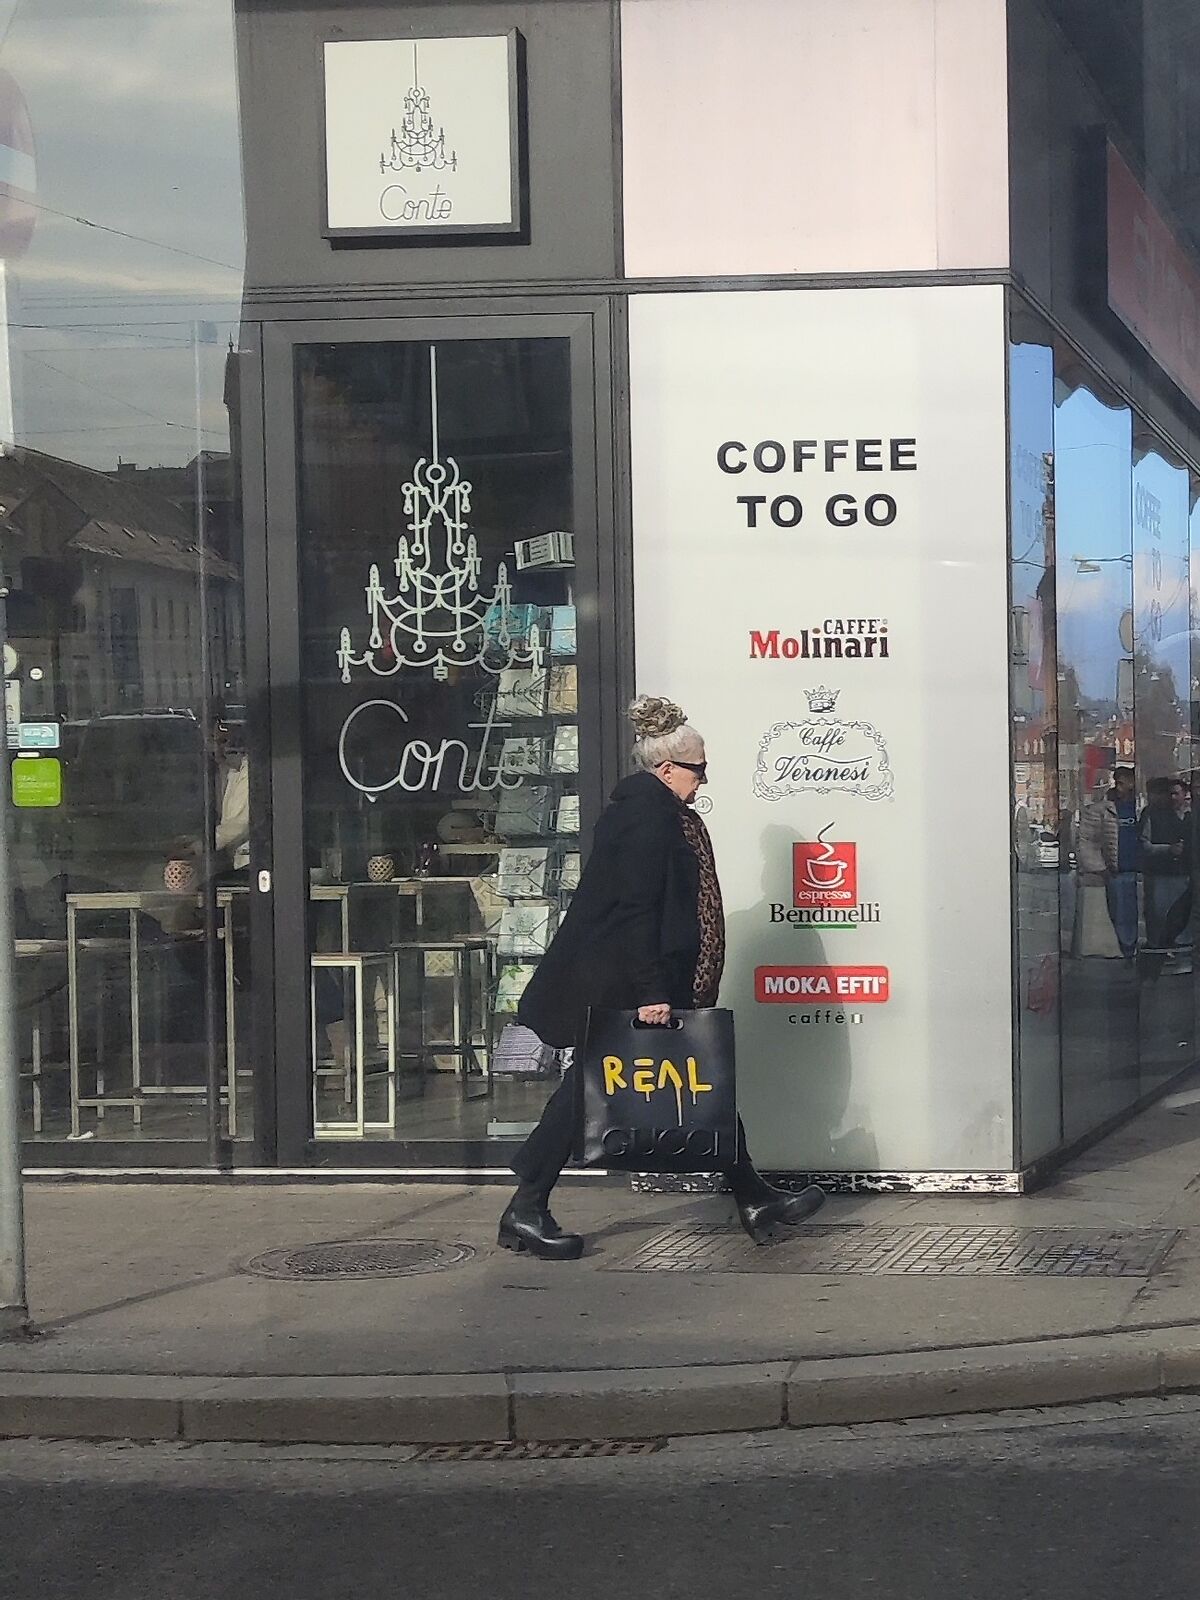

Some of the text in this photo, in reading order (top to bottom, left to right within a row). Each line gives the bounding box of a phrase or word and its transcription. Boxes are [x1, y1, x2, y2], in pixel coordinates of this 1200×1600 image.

[379, 183, 453, 221] Conte
[716, 438, 918, 475] COFFEE
[736, 493, 899, 528] TO GO
[748, 625, 890, 659] Molinari
[774, 754, 873, 783] Veronesi
[768, 902, 881, 924] Bendinelli
[798, 890, 852, 904] espresso
[764, 976, 880, 995] MOKA EFTI
[602, 1055, 714, 1104] REAL
